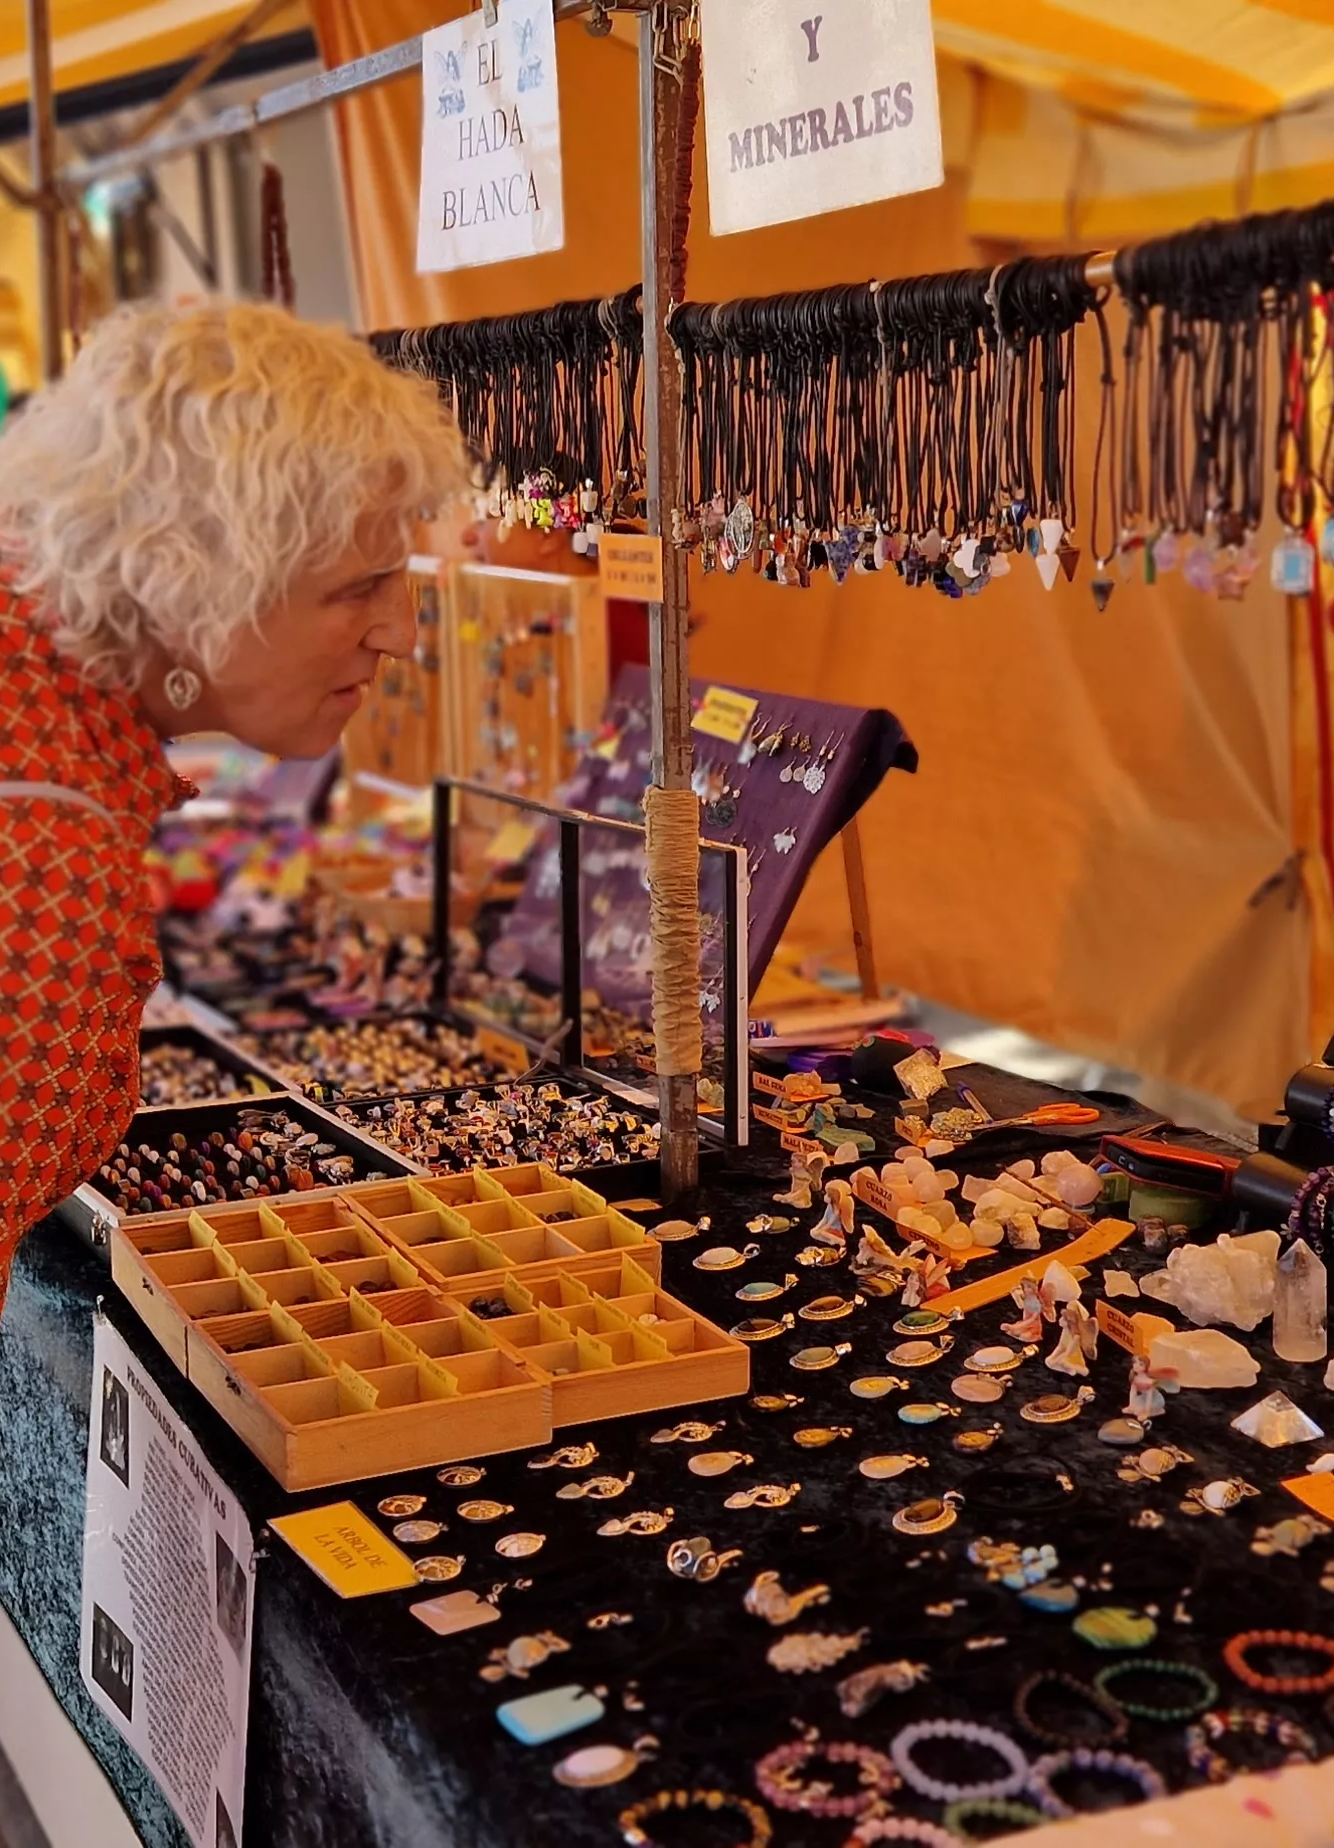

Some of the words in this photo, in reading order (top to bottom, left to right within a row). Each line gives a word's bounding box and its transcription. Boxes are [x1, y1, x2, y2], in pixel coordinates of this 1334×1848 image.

[477, 40, 504, 88] EL
[799, 16, 825, 63] Y
[457, 103, 526, 161] HADA
[728, 81, 915, 173] MINERALES
[441, 170, 541, 231] BLANCA
[127, 1365, 177, 1450] PROPIEDADES
[177, 1440, 227, 1520] CURATIVAS
[313, 1533, 333, 1549] LA
[328, 1546, 359, 1571] VIDA
[366, 1552, 387, 1569] DE
